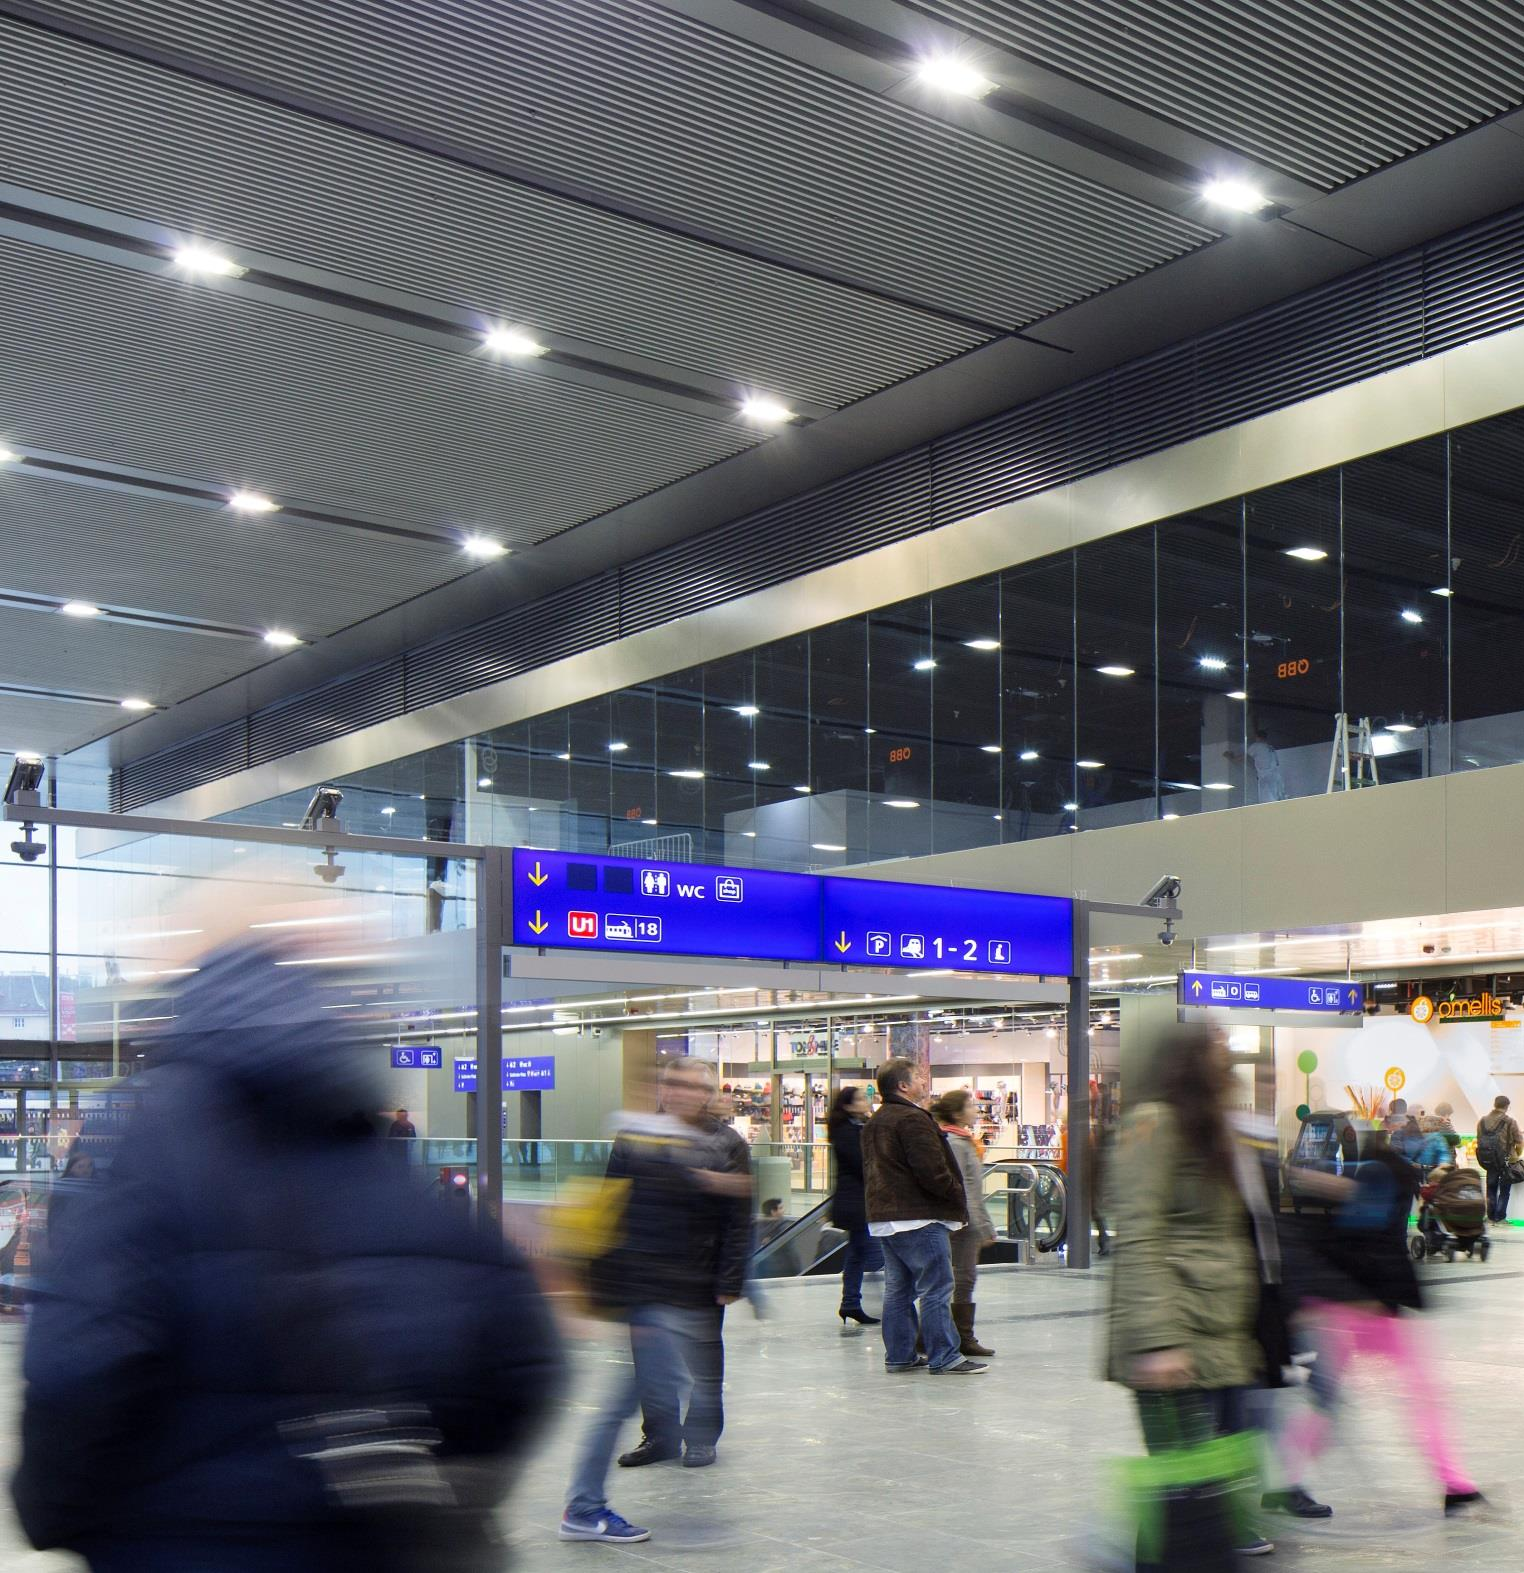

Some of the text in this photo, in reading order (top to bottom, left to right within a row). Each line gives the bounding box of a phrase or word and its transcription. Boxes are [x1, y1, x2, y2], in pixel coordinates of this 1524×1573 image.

[677, 884, 705, 899] WC
[572, 917, 595, 933] U1
[638, 922, 658, 936] 18
